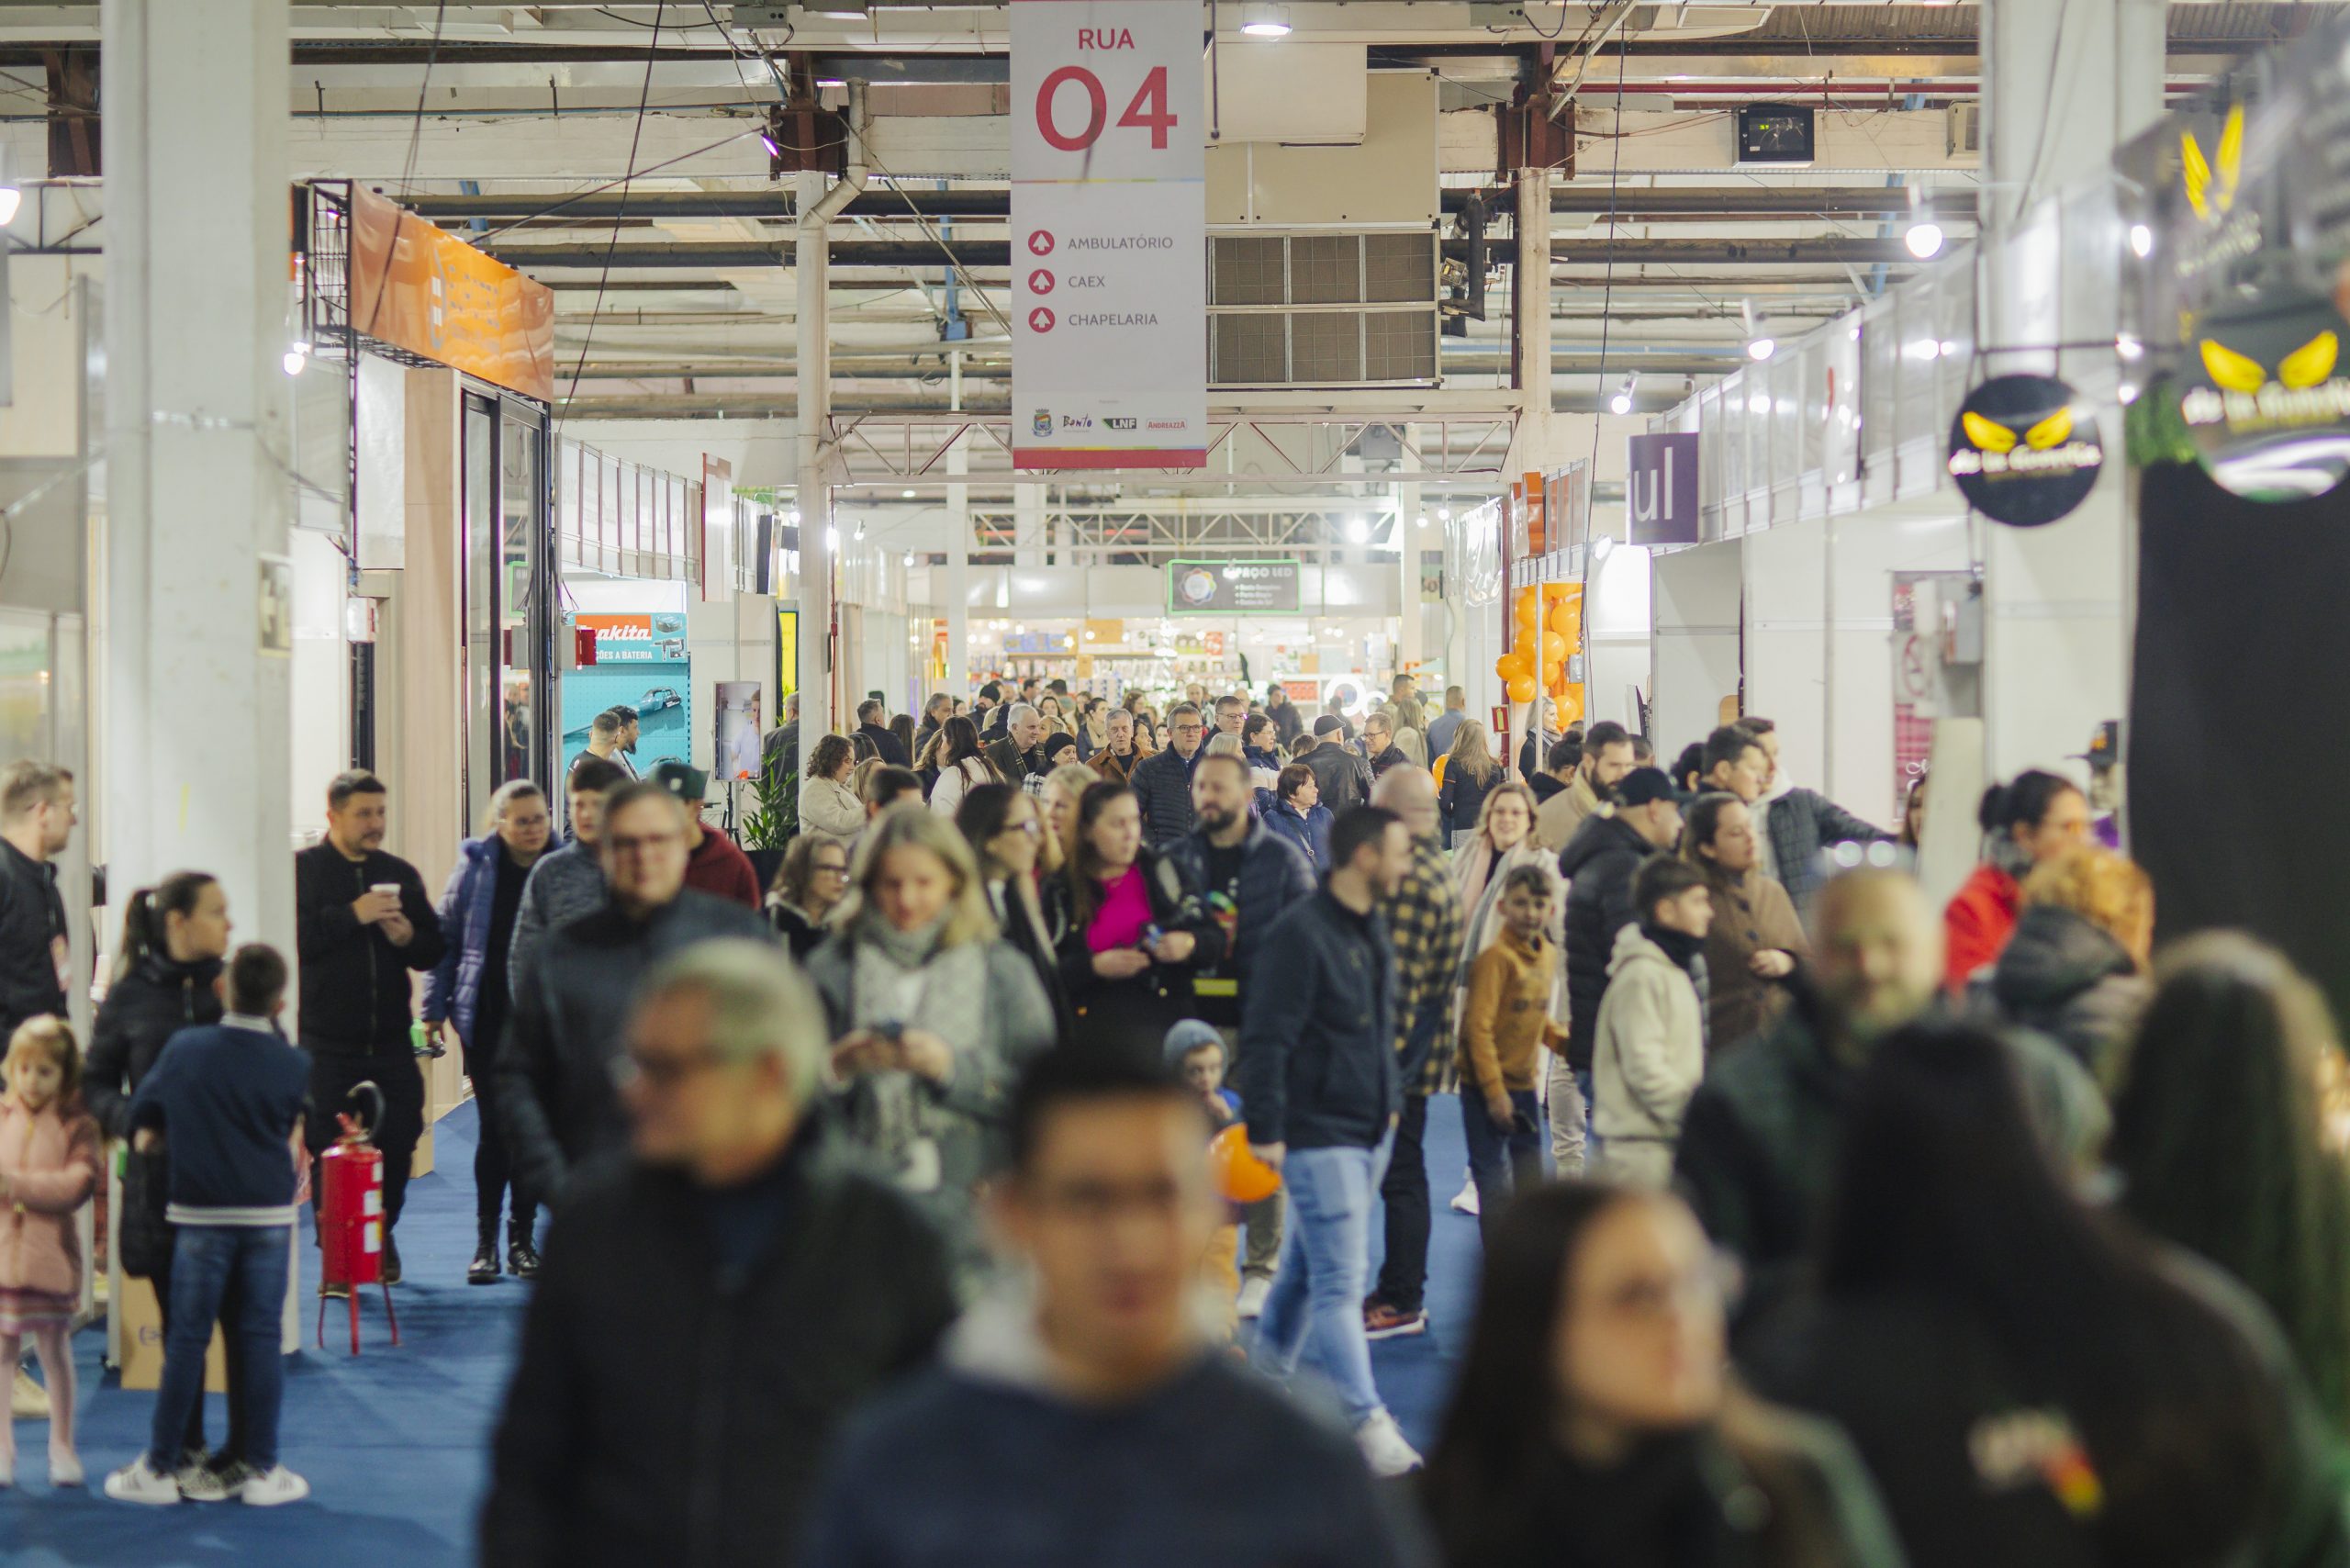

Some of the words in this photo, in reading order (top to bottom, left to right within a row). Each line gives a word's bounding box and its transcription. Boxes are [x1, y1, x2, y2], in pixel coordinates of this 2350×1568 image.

[1079, 28, 1135, 50] RUA
[1035, 65, 1178, 151] 04
[1068, 233, 1173, 250] AMBULATÓRIO
[1069, 275, 1105, 287] CAEX
[1069, 313, 1158, 326] CHAPELARIA
[1063, 413, 1092, 428] Bento
[1112, 419, 1136, 429] LNF
[593, 624, 653, 641] akita
[615, 651, 621, 660] A
[621, 650, 653, 660] BATERIA
